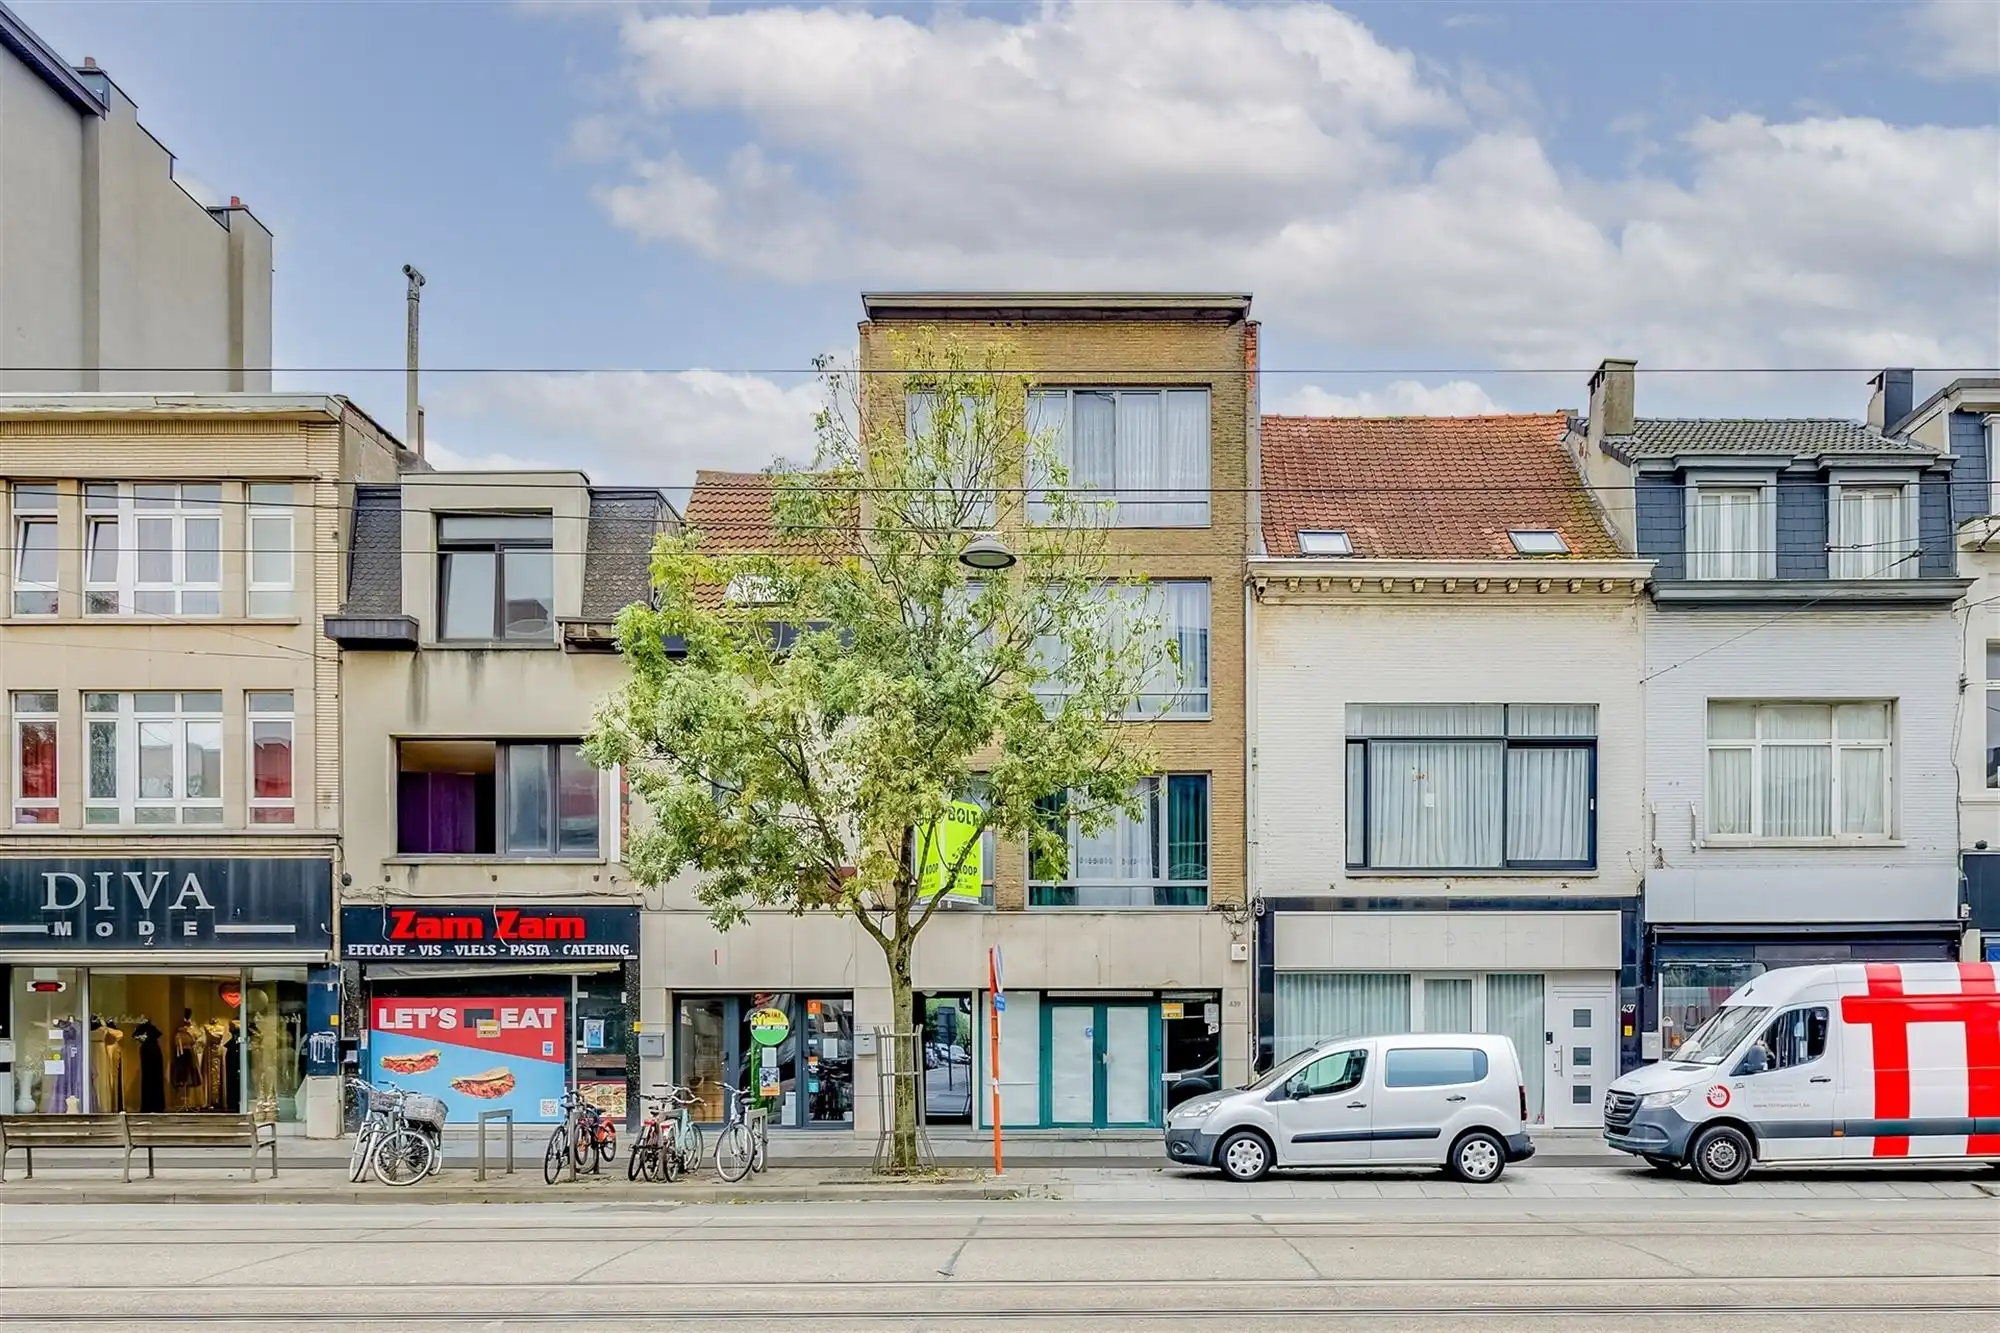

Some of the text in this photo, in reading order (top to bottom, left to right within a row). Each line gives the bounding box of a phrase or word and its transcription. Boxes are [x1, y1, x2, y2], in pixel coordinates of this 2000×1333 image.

[41, 871, 215, 910] DIVA
[54, 921, 198, 936] MODE
[391, 910, 585, 938] Zam Zam
[347, 944, 406, 956] EETCAFE
[418, 944, 442, 956] VIS
[510, 944, 550, 956] PASTA
[562, 944, 629, 956] CATERING
[378, 1007, 457, 1029] LET'S
[501, 1008, 557, 1029] EAT
